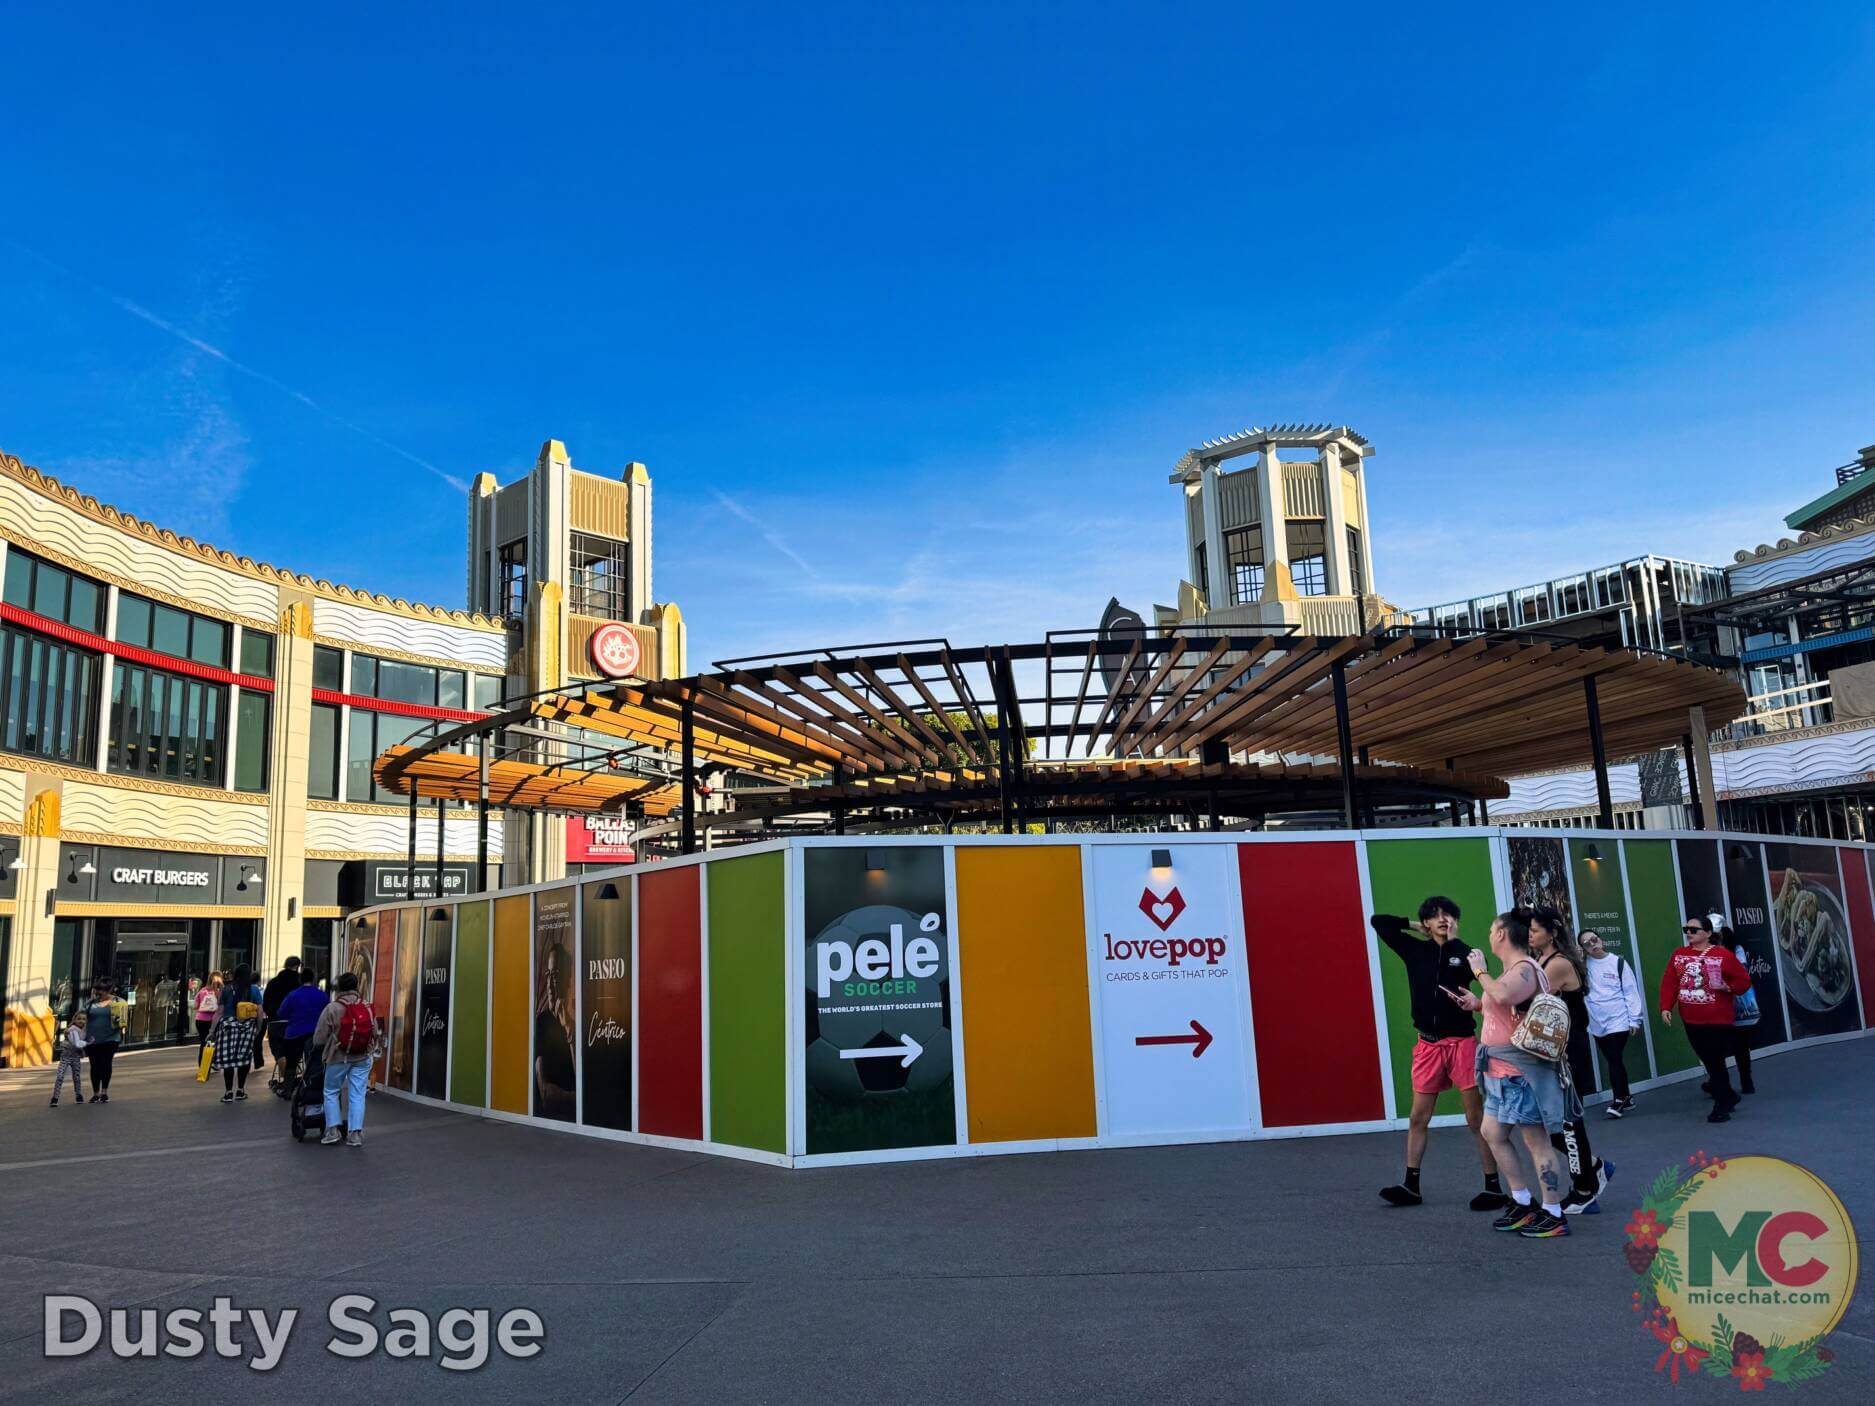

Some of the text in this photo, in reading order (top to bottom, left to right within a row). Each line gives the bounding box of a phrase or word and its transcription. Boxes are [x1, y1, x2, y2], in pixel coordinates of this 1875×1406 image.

[595, 830, 631, 845] POIN
[113, 867, 209, 886] CRAFT BURGERS
[1736, 907, 1764, 925] PASEO
[816, 912, 940, 998] pelé
[1103, 933, 1226, 966] lovepop
[425, 967, 447, 985] PASEO
[589, 958, 625, 981] PASEO
[1106, 968, 1229, 981] CARDS & GIFTS THAT POP
[843, 980, 917, 997] SOCCER
[832, 1005, 860, 1014] WORLD'S
[861, 1003, 894, 1012] GREATEST
[895, 1002, 921, 1010] SOCCER
[922, 1001, 943, 1009] STORE
[1563, 1130, 1581, 1175] MOUSE
